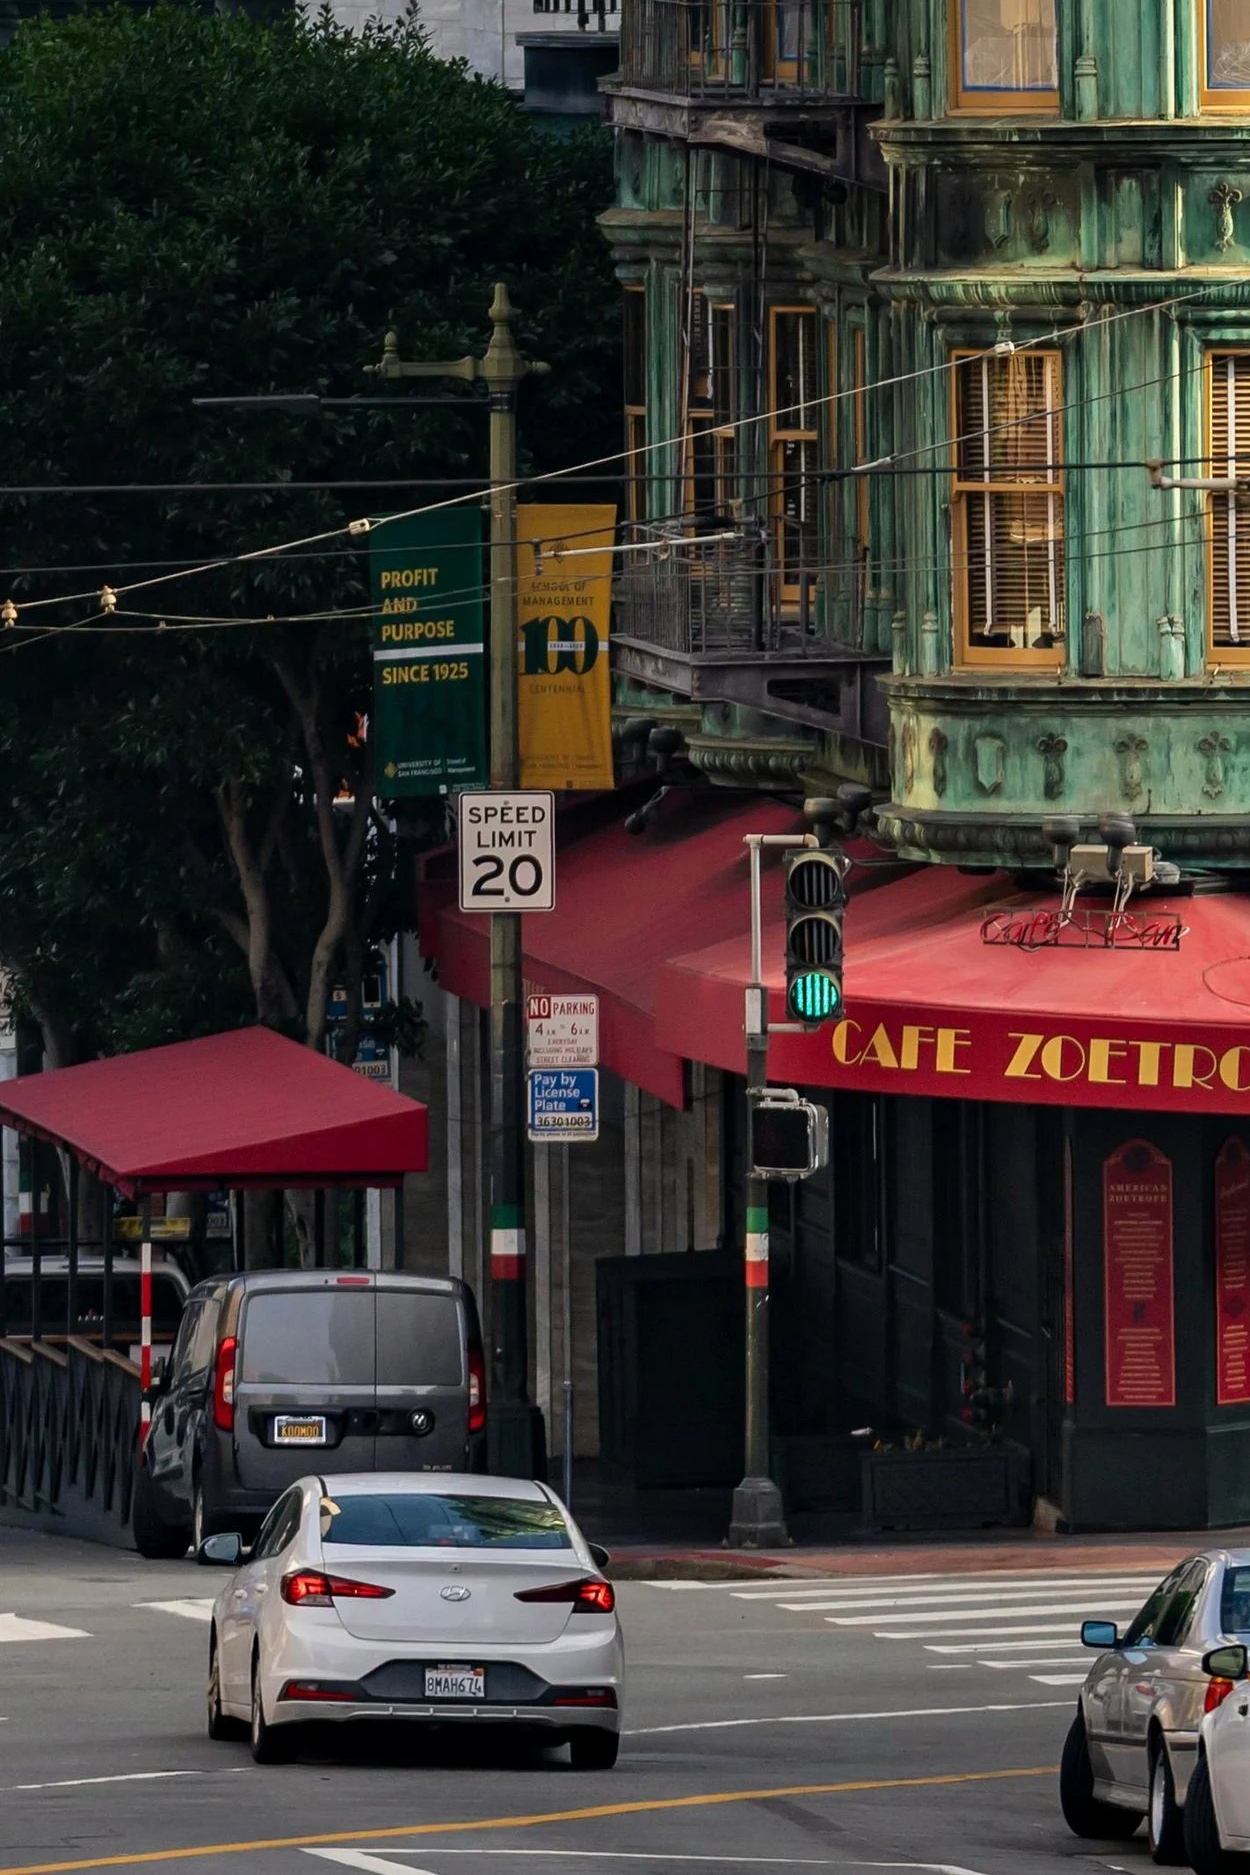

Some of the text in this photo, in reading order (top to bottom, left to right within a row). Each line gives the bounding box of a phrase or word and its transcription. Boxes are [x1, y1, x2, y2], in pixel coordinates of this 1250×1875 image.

[381, 568, 438, 588] PROFIT
[382, 597, 418, 614] AND
[523, 597, 594, 606] MANAGEMENT
[382, 620, 455, 641] PURPOSE
[519, 615, 599, 676] 100
[382, 662, 468, 685] SINCE 1925
[468, 806, 546, 824] SPEED
[477, 830, 537, 848] LIMIT
[472, 854, 543, 896] 20
[1107, 912, 1183, 946] Bar
[530, 998, 594, 1016] NO PARKING
[535, 1023, 543, 1036] 4
[571, 1023, 578, 1035] 6
[832, 1020, 972, 1074] CAFE
[534, 1072, 577, 1088] Pay by
[535, 1085, 580, 1098] License
[535, 1099, 566, 1111] Plate
[536, 1116, 591, 1126] 36301003
[427, 1677, 482, 1695] 8MAH674
